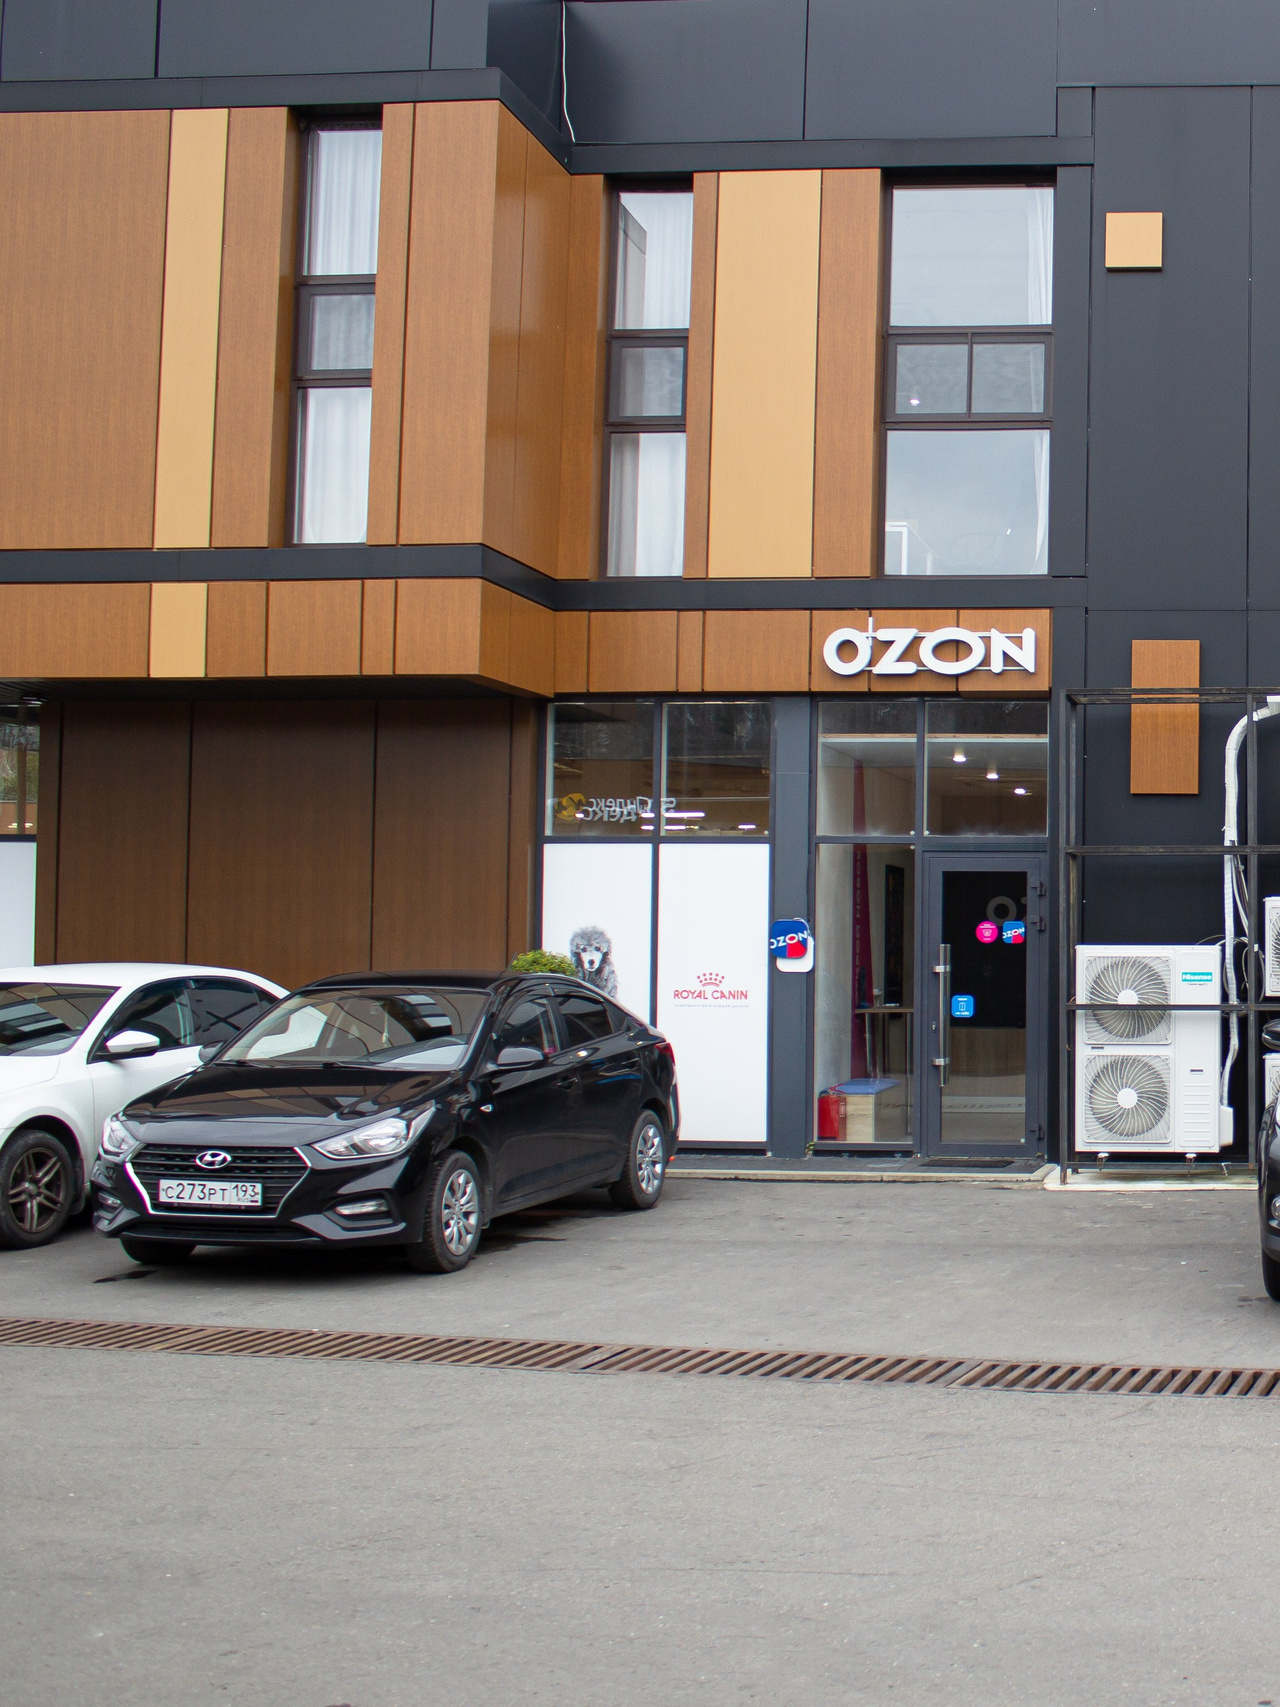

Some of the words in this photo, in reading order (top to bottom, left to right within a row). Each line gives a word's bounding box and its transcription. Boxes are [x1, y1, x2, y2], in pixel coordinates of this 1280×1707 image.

[823, 627, 1036, 675] OZON
[769, 930, 808, 949] OZON
[1002, 927, 1025, 939] OZON
[673, 989, 708, 1000] ROYAL
[711, 989, 748, 1000] CANIN
[165, 1183, 228, 1201] С273РТ
[232, 1184, 257, 1198] 193
